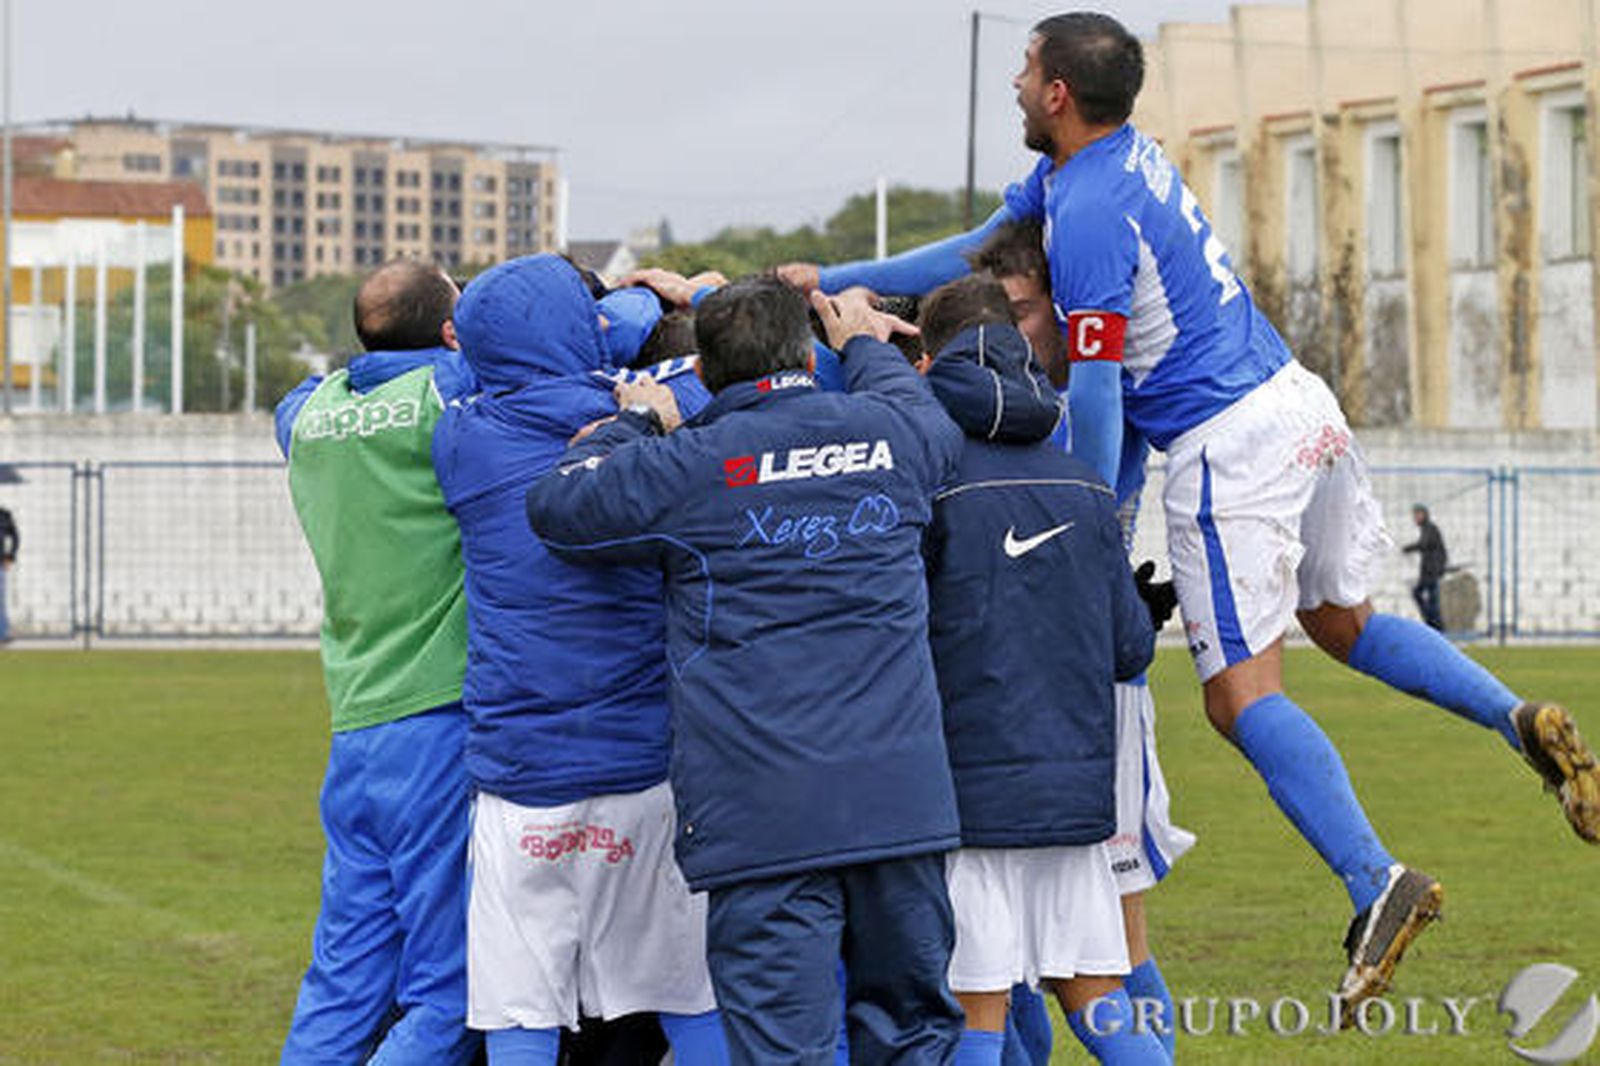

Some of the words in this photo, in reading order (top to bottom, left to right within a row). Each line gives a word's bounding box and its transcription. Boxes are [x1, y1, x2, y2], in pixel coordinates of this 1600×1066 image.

[1077, 316, 1104, 356] C
[758, 440, 893, 483] LEGEA
[738, 506, 840, 558] Xerez
[848, 494, 900, 535] CD
